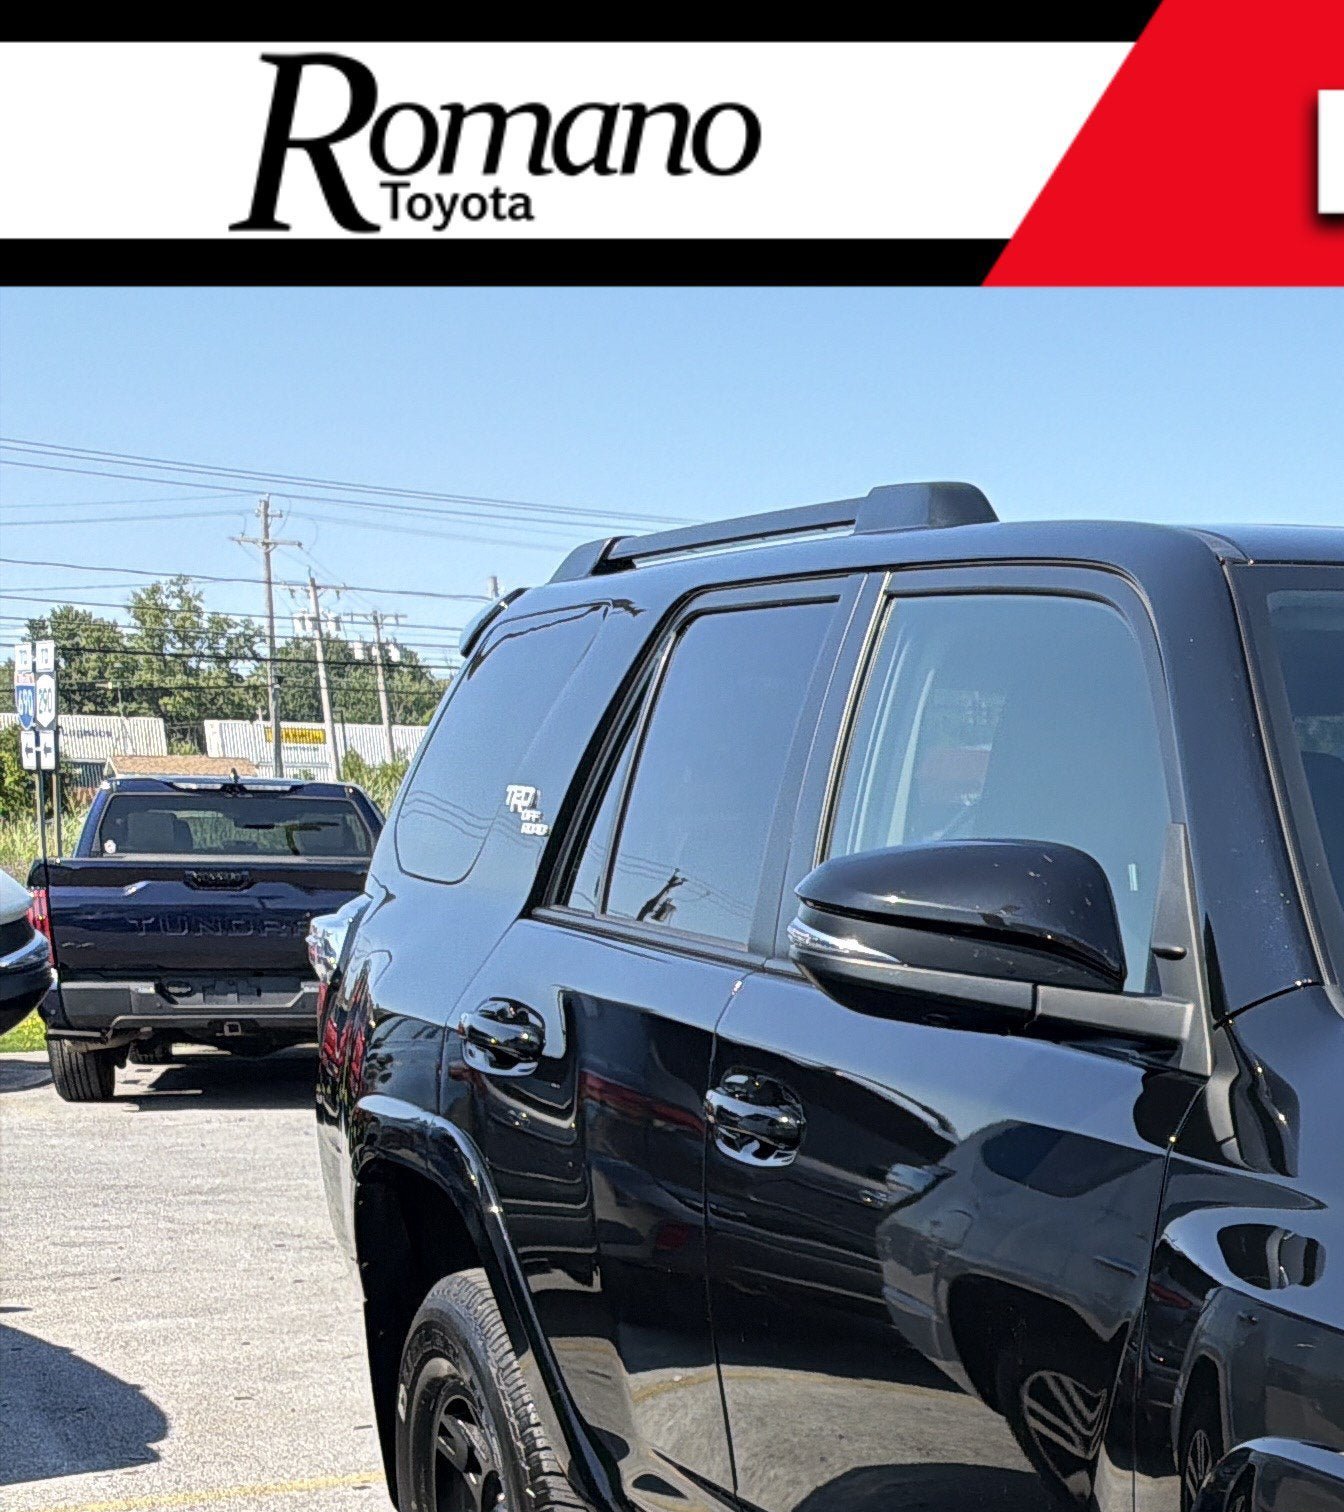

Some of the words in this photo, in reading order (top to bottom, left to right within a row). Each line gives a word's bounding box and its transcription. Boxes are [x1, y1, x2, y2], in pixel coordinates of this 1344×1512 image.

[18, 688, 33, 717] 690
[38, 687, 53, 715] 290
[505, 784, 537, 813] TRD
